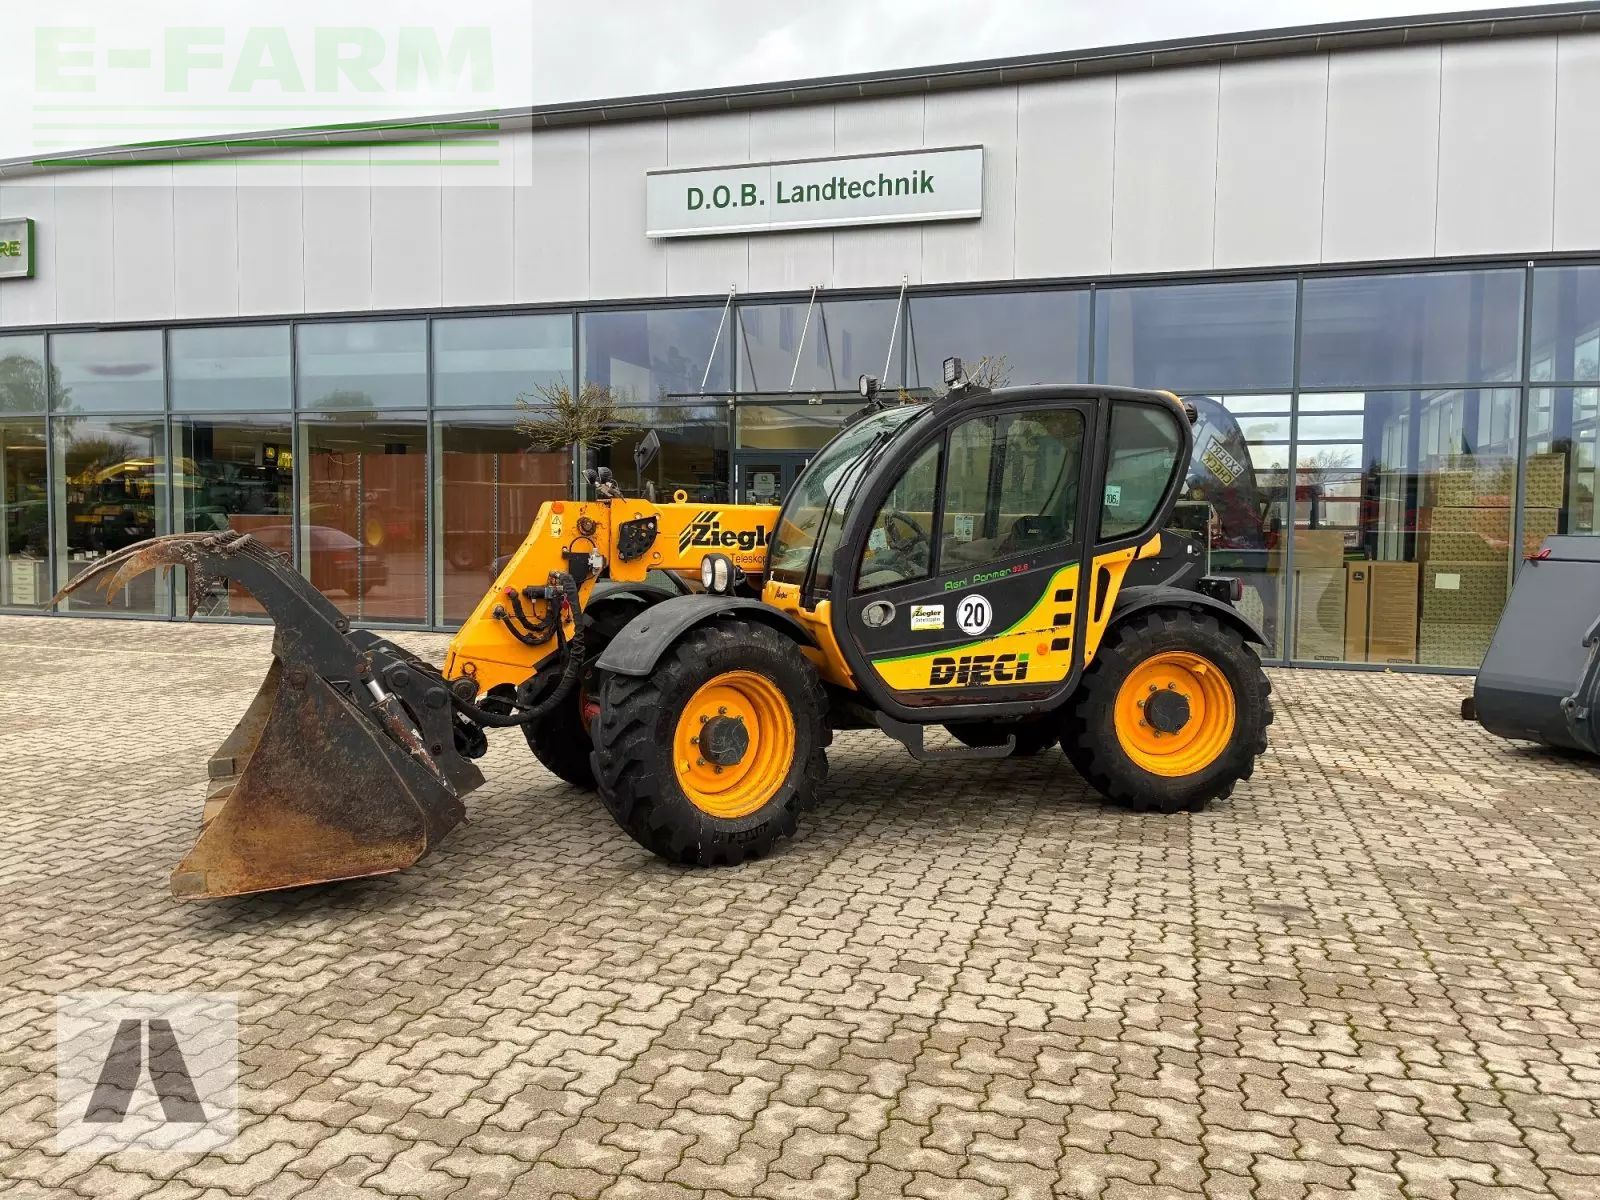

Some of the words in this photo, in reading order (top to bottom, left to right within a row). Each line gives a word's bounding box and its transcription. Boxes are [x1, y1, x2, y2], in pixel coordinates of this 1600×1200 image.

[687, 183, 765, 211] D.O.B.
[777, 170, 935, 204] Landtechnik
[944, 577, 968, 592] Agri
[973, 568, 1012, 584] Farmer
[915, 609, 942, 618] Ziegler
[963, 602, 985, 627] 20
